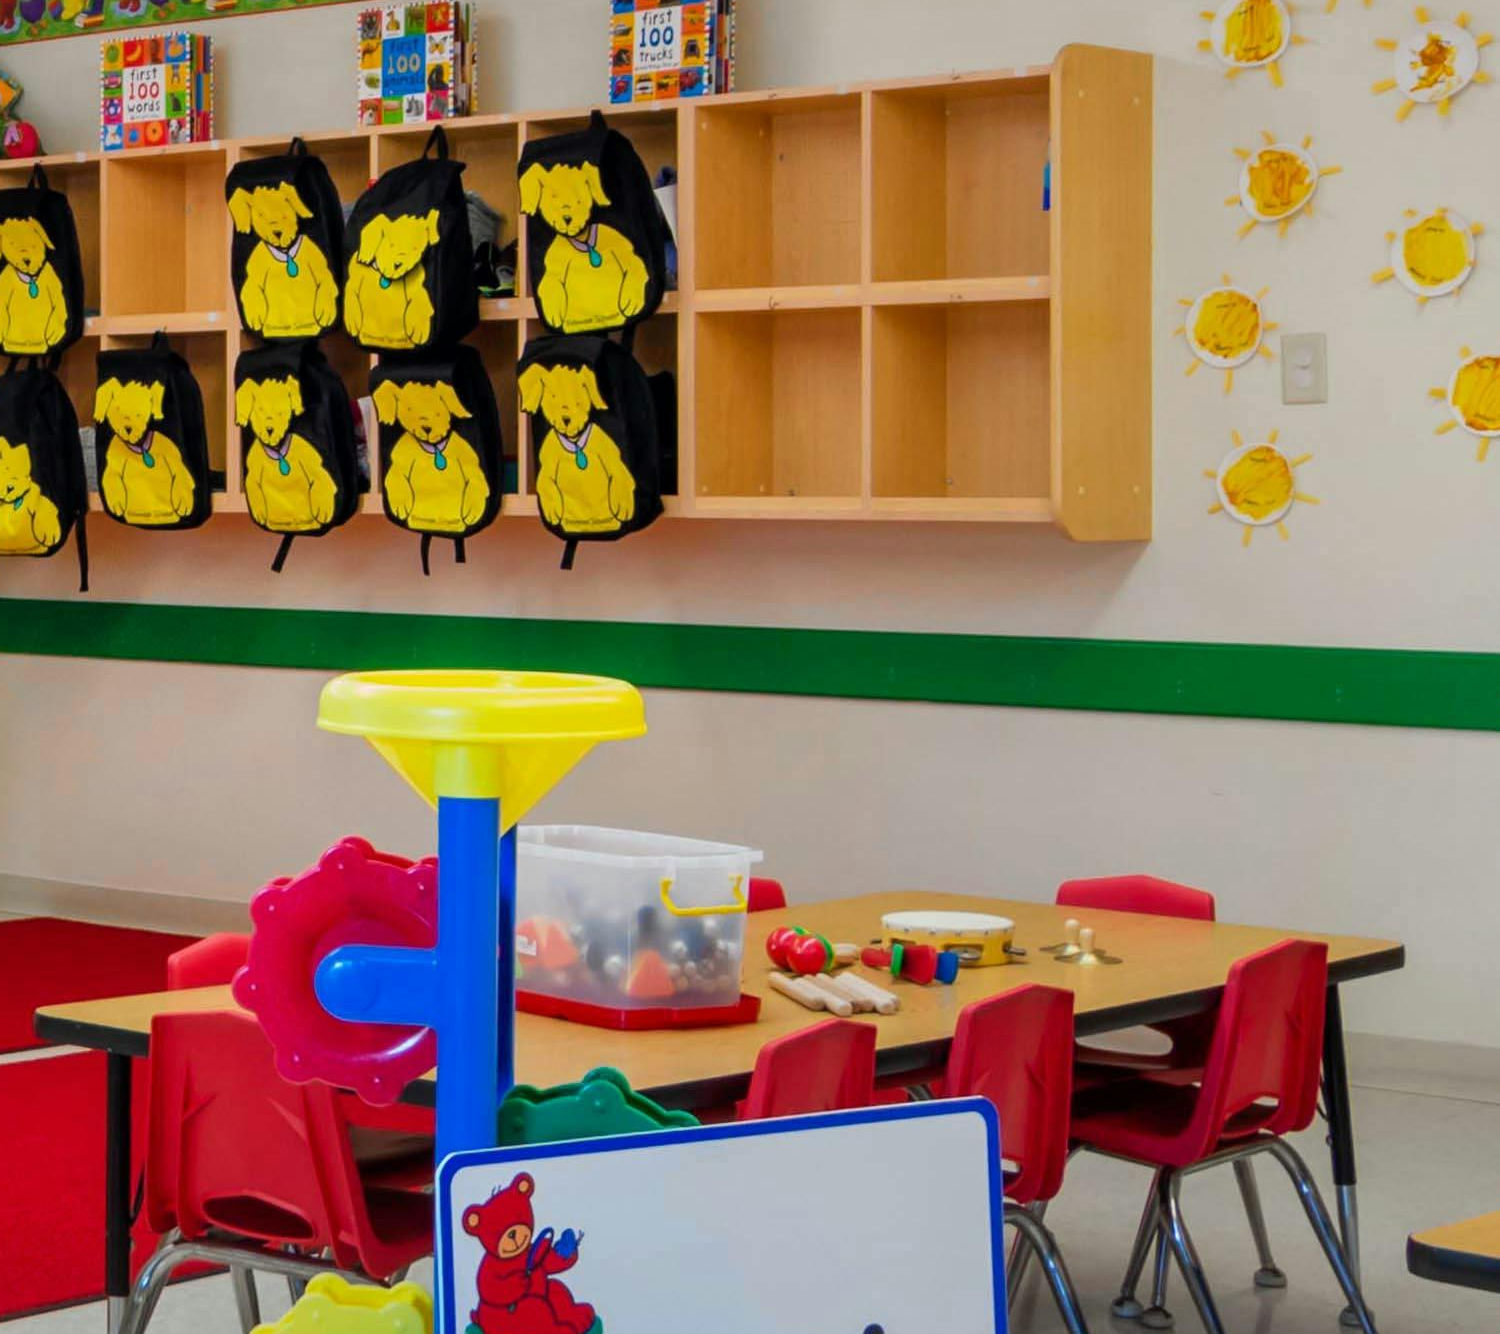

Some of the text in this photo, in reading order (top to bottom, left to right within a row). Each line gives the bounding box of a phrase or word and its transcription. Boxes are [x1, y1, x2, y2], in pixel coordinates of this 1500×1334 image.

[642, 8, 673, 26] first
[640, 27, 674, 47] 100
[388, 53, 421, 75] 100
[130, 67, 157, 81] first
[128, 82, 160, 100] 100
[127, 101, 160, 113] words
